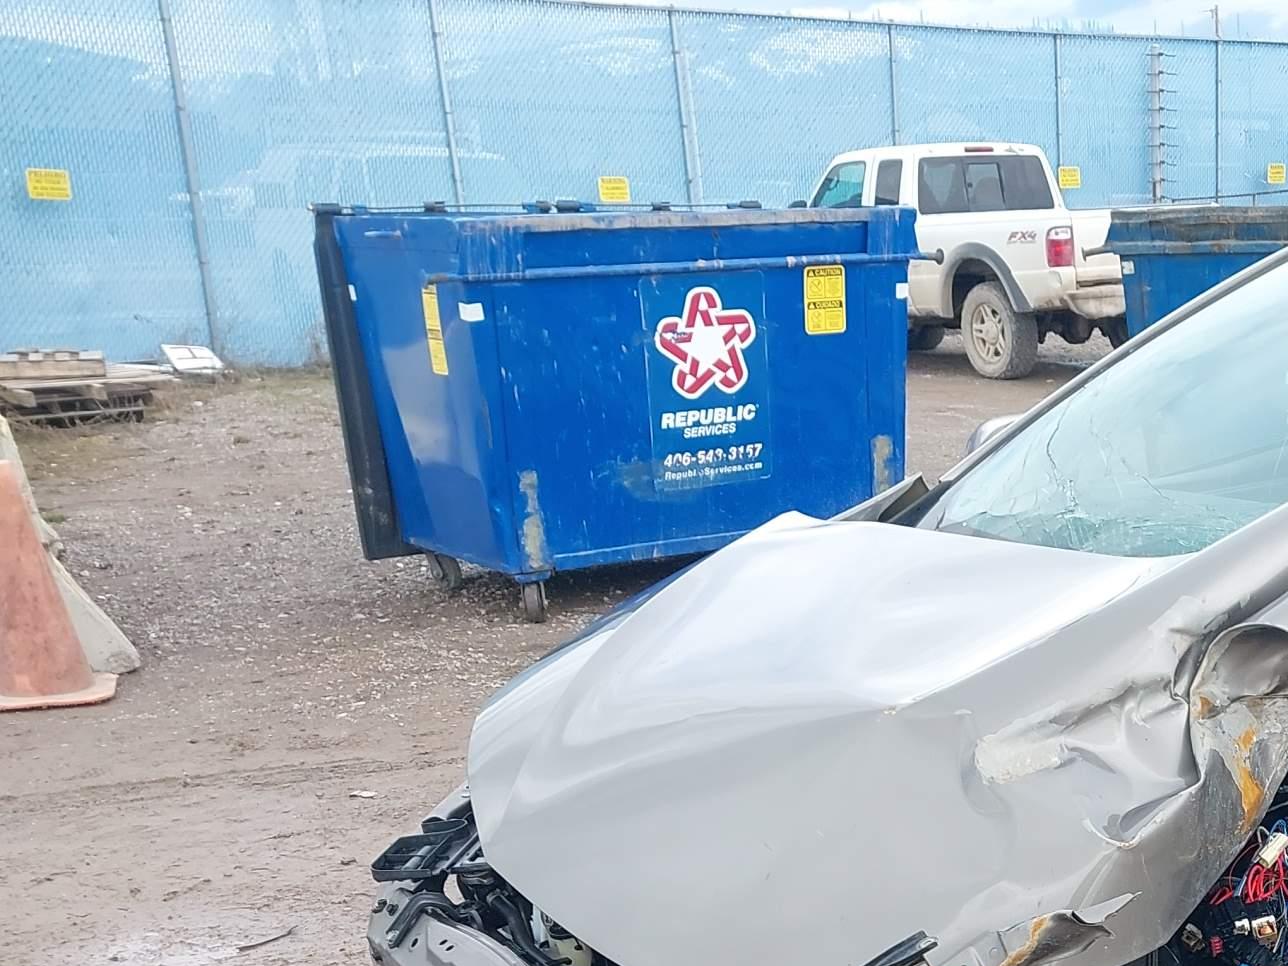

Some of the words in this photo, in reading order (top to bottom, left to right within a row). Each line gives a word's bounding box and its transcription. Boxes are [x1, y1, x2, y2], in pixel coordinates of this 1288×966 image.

[1008, 231, 1037, 240] FX4
[661, 403, 757, 429] REPUBLIC
[683, 423, 737, 439] SERVICES
